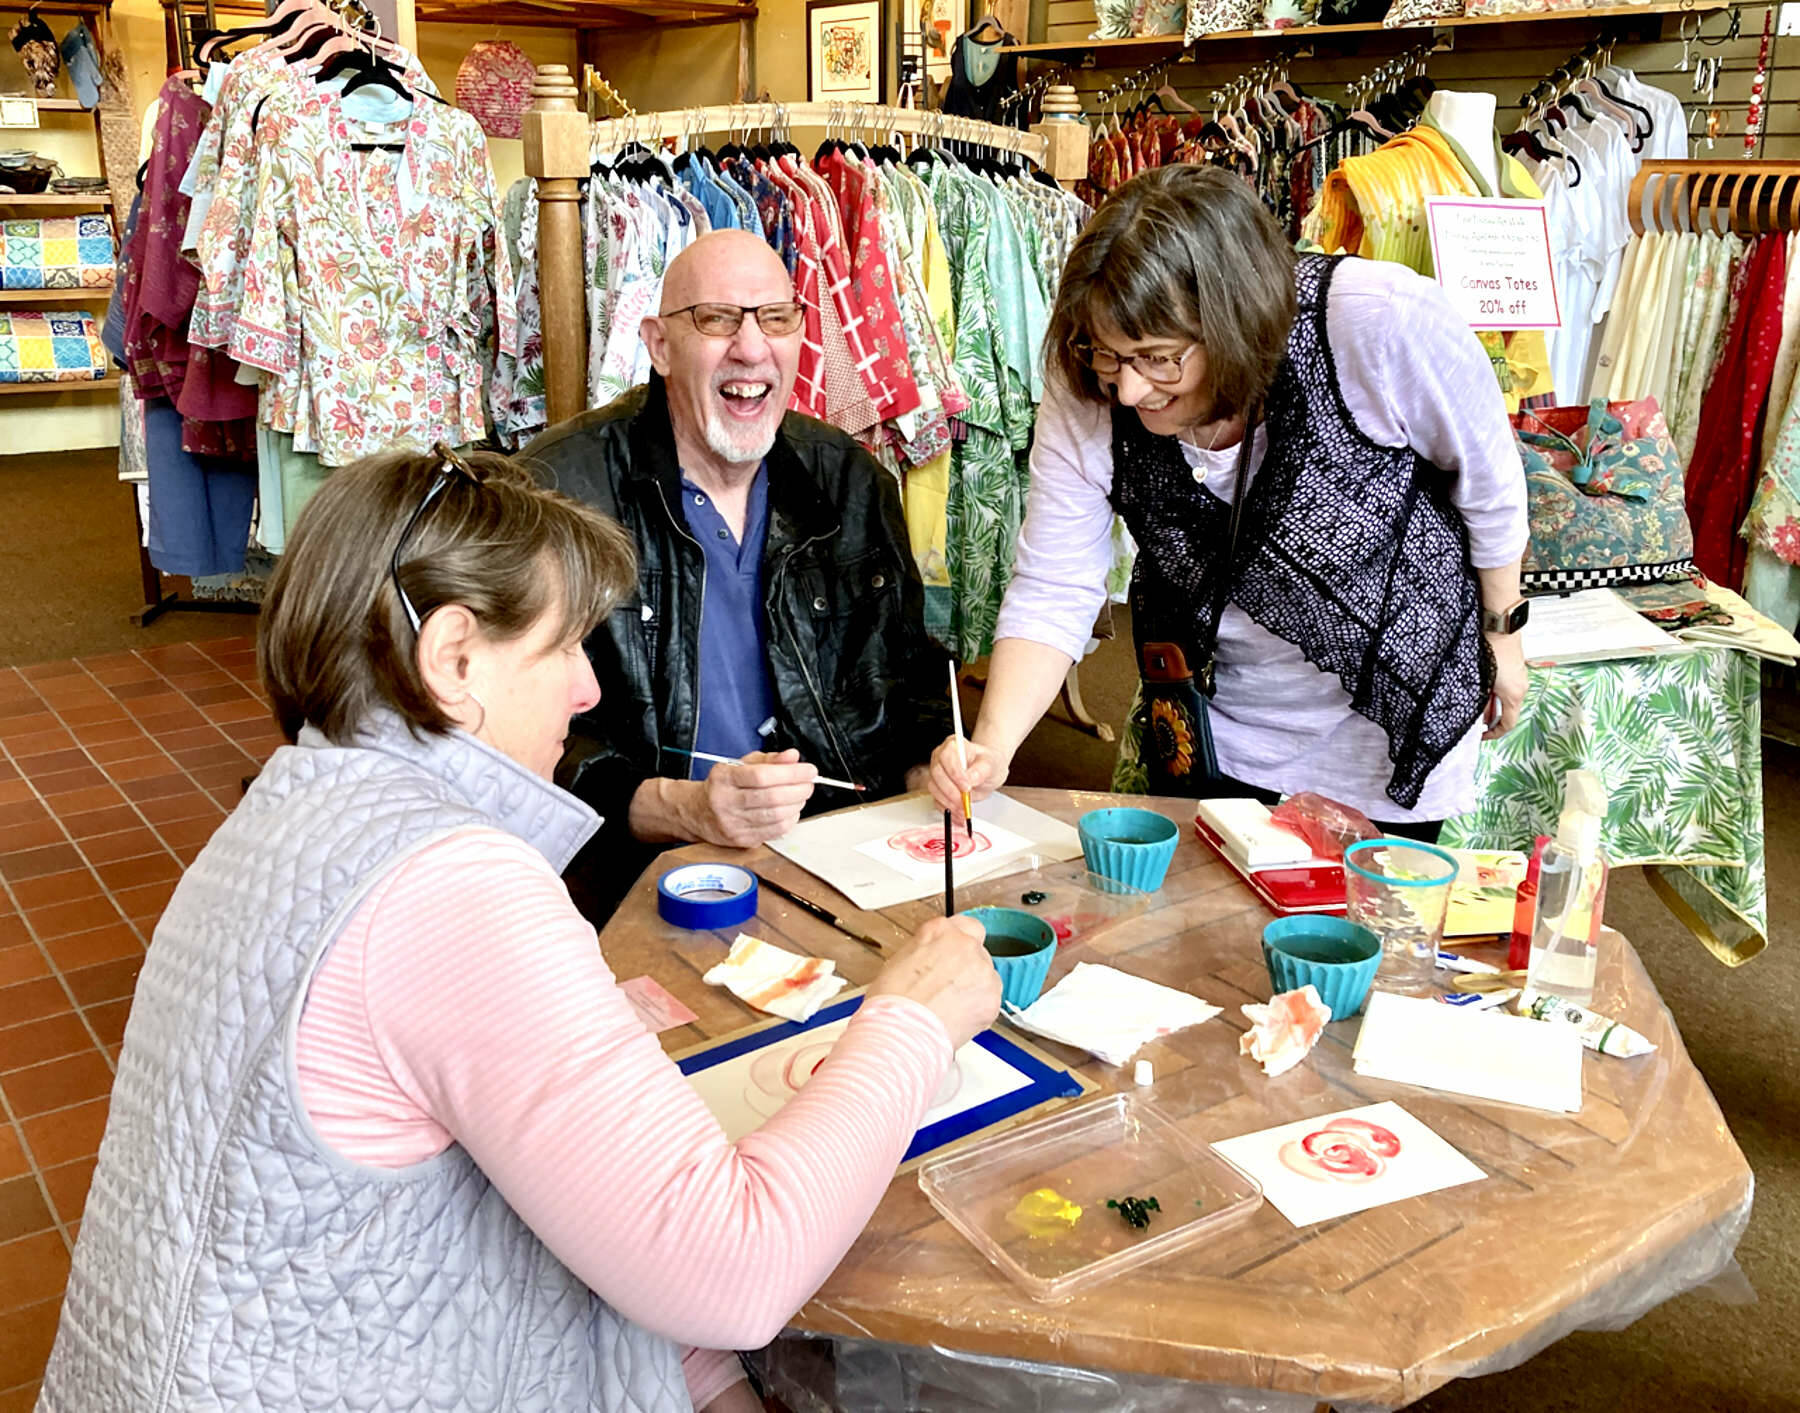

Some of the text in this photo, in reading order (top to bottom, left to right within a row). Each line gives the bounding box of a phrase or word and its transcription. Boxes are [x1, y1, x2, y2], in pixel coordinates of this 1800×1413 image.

[1460, 275, 1538, 291] Canvas Totes
[1479, 299, 1526, 315] 20% off
